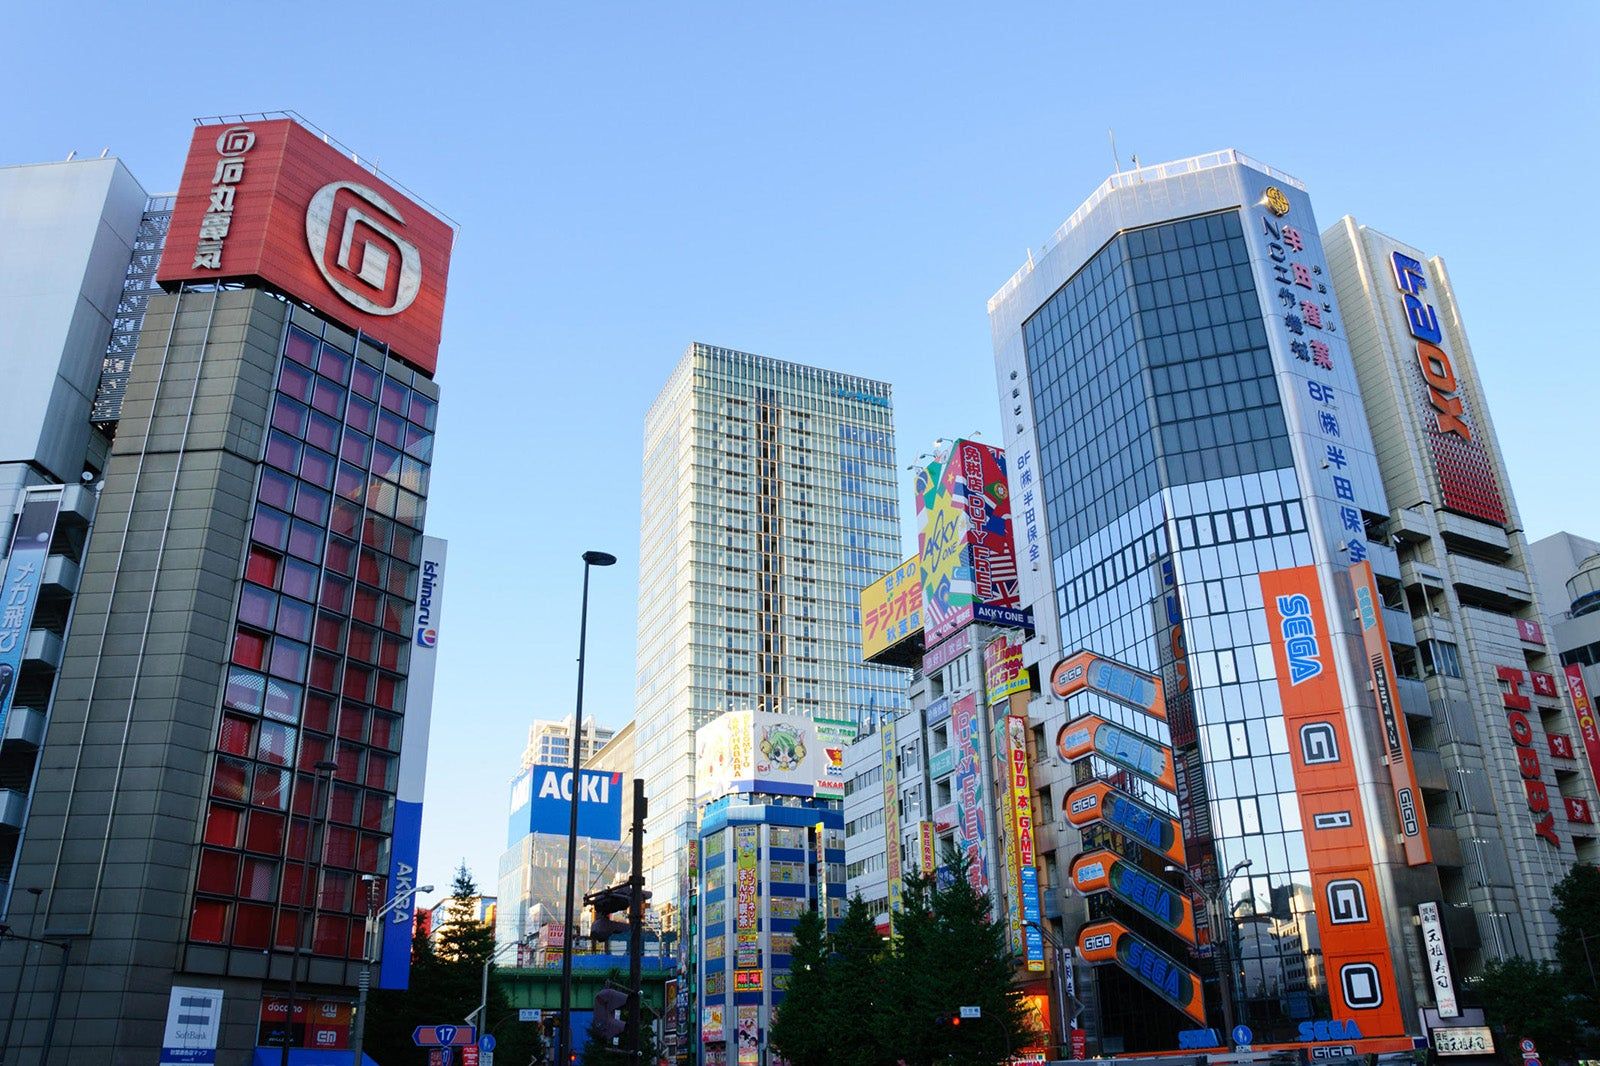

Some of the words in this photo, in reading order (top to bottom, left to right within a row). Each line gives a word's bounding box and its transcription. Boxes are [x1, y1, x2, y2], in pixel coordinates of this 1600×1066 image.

[192, 157, 245, 270] 石丸電気
[1281, 225, 1332, 371] 半田産業
[1390, 251, 1472, 441] LAOX
[1308, 381, 1335, 404] 8F
[963, 445, 983, 494] 免税店
[1017, 451, 1031, 471] 8F
[968, 494, 988, 545] DUTY
[942, 542, 958, 560] ONE
[973, 546, 993, 599] FREE
[418, 560, 439, 625] ishimaru
[885, 562, 916, 593] 世界の
[886, 610, 920, 643] 秋葉原
[978, 607, 1003, 619] AKKY
[1004, 610, 1024, 622] ONE
[1356, 585, 1376, 631] SEGA
[1276, 593, 1323, 687] SEGA
[1098, 665, 1144, 704] SEGA
[731, 716, 741, 778] AKIHABARA
[958, 712, 975, 774] DUTY
[1106, 730, 1152, 775] SEGA
[1495, 665, 1561, 849] HOBBY
[539, 771, 610, 804] AOKI
[963, 774, 979, 840] FREE
[1113, 797, 1160, 848] SEGA
[393, 862, 414, 924] AKBA
[747, 868, 756, 928] インターネット
[1120, 868, 1170, 920] SEGA
[1127, 941, 1179, 999] SEGA
[1427, 929, 1449, 988] 元祖寿司
[175, 1031, 207, 1040] SoftBank
[440, 1028, 453, 1041] 17
[1298, 1019, 1363, 1042] SEGA
